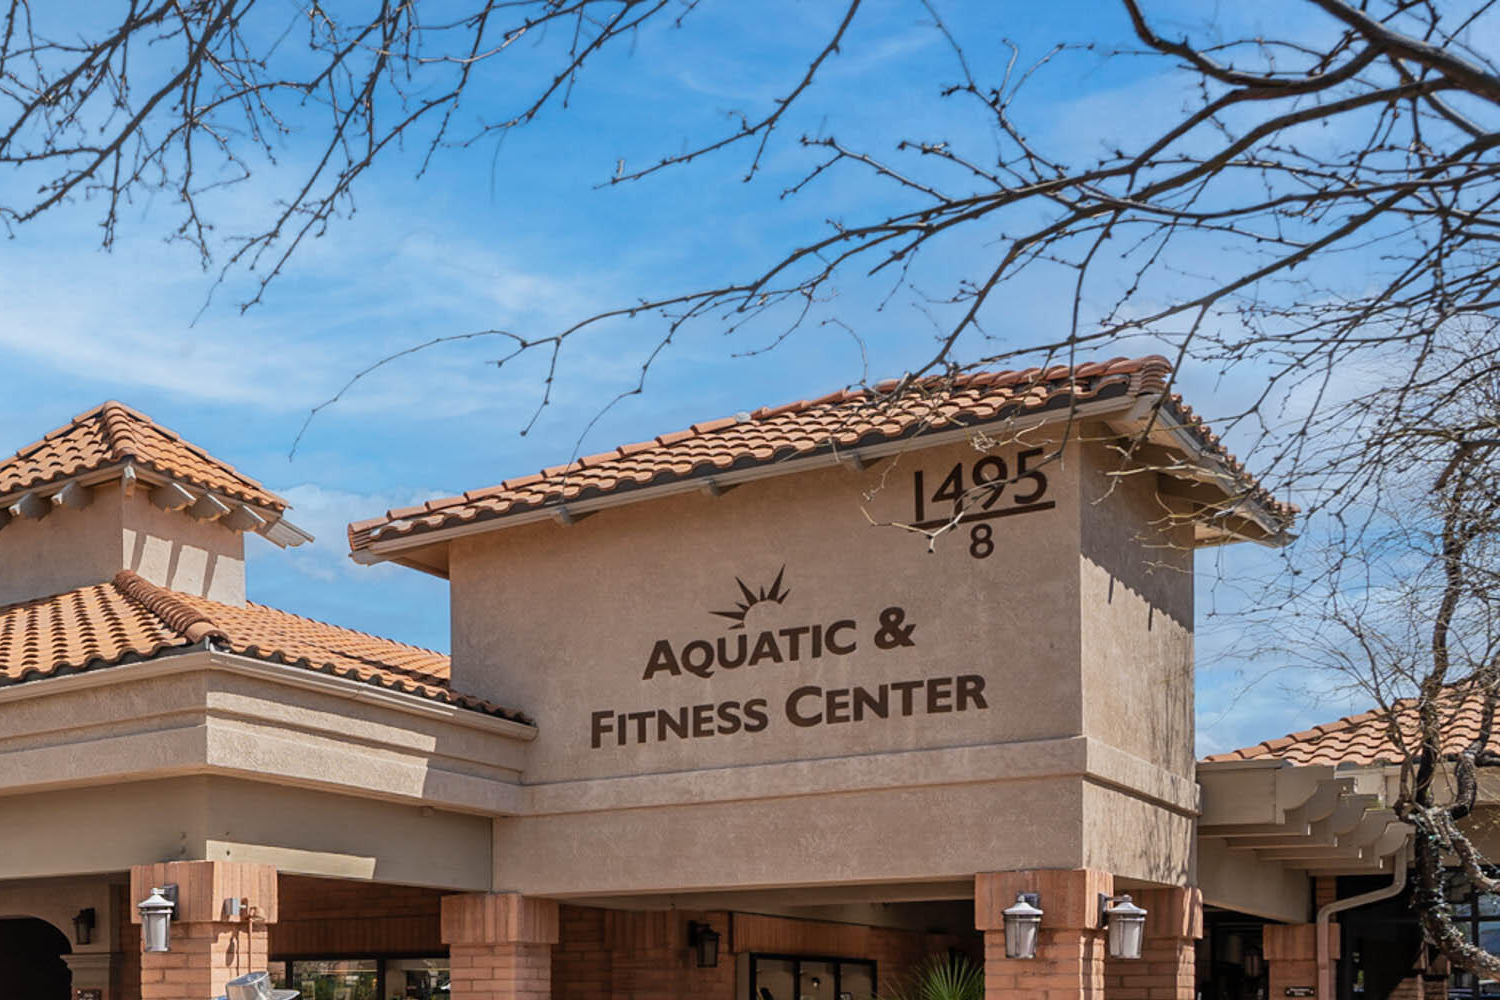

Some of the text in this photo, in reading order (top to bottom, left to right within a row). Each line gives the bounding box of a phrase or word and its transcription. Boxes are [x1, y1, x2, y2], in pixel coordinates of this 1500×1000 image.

[914, 447, 1048, 523] 1495
[969, 523, 995, 559] 8
[642, 606, 917, 681] AQUATIC &
[591, 674, 989, 749] FITNESS CENTER
